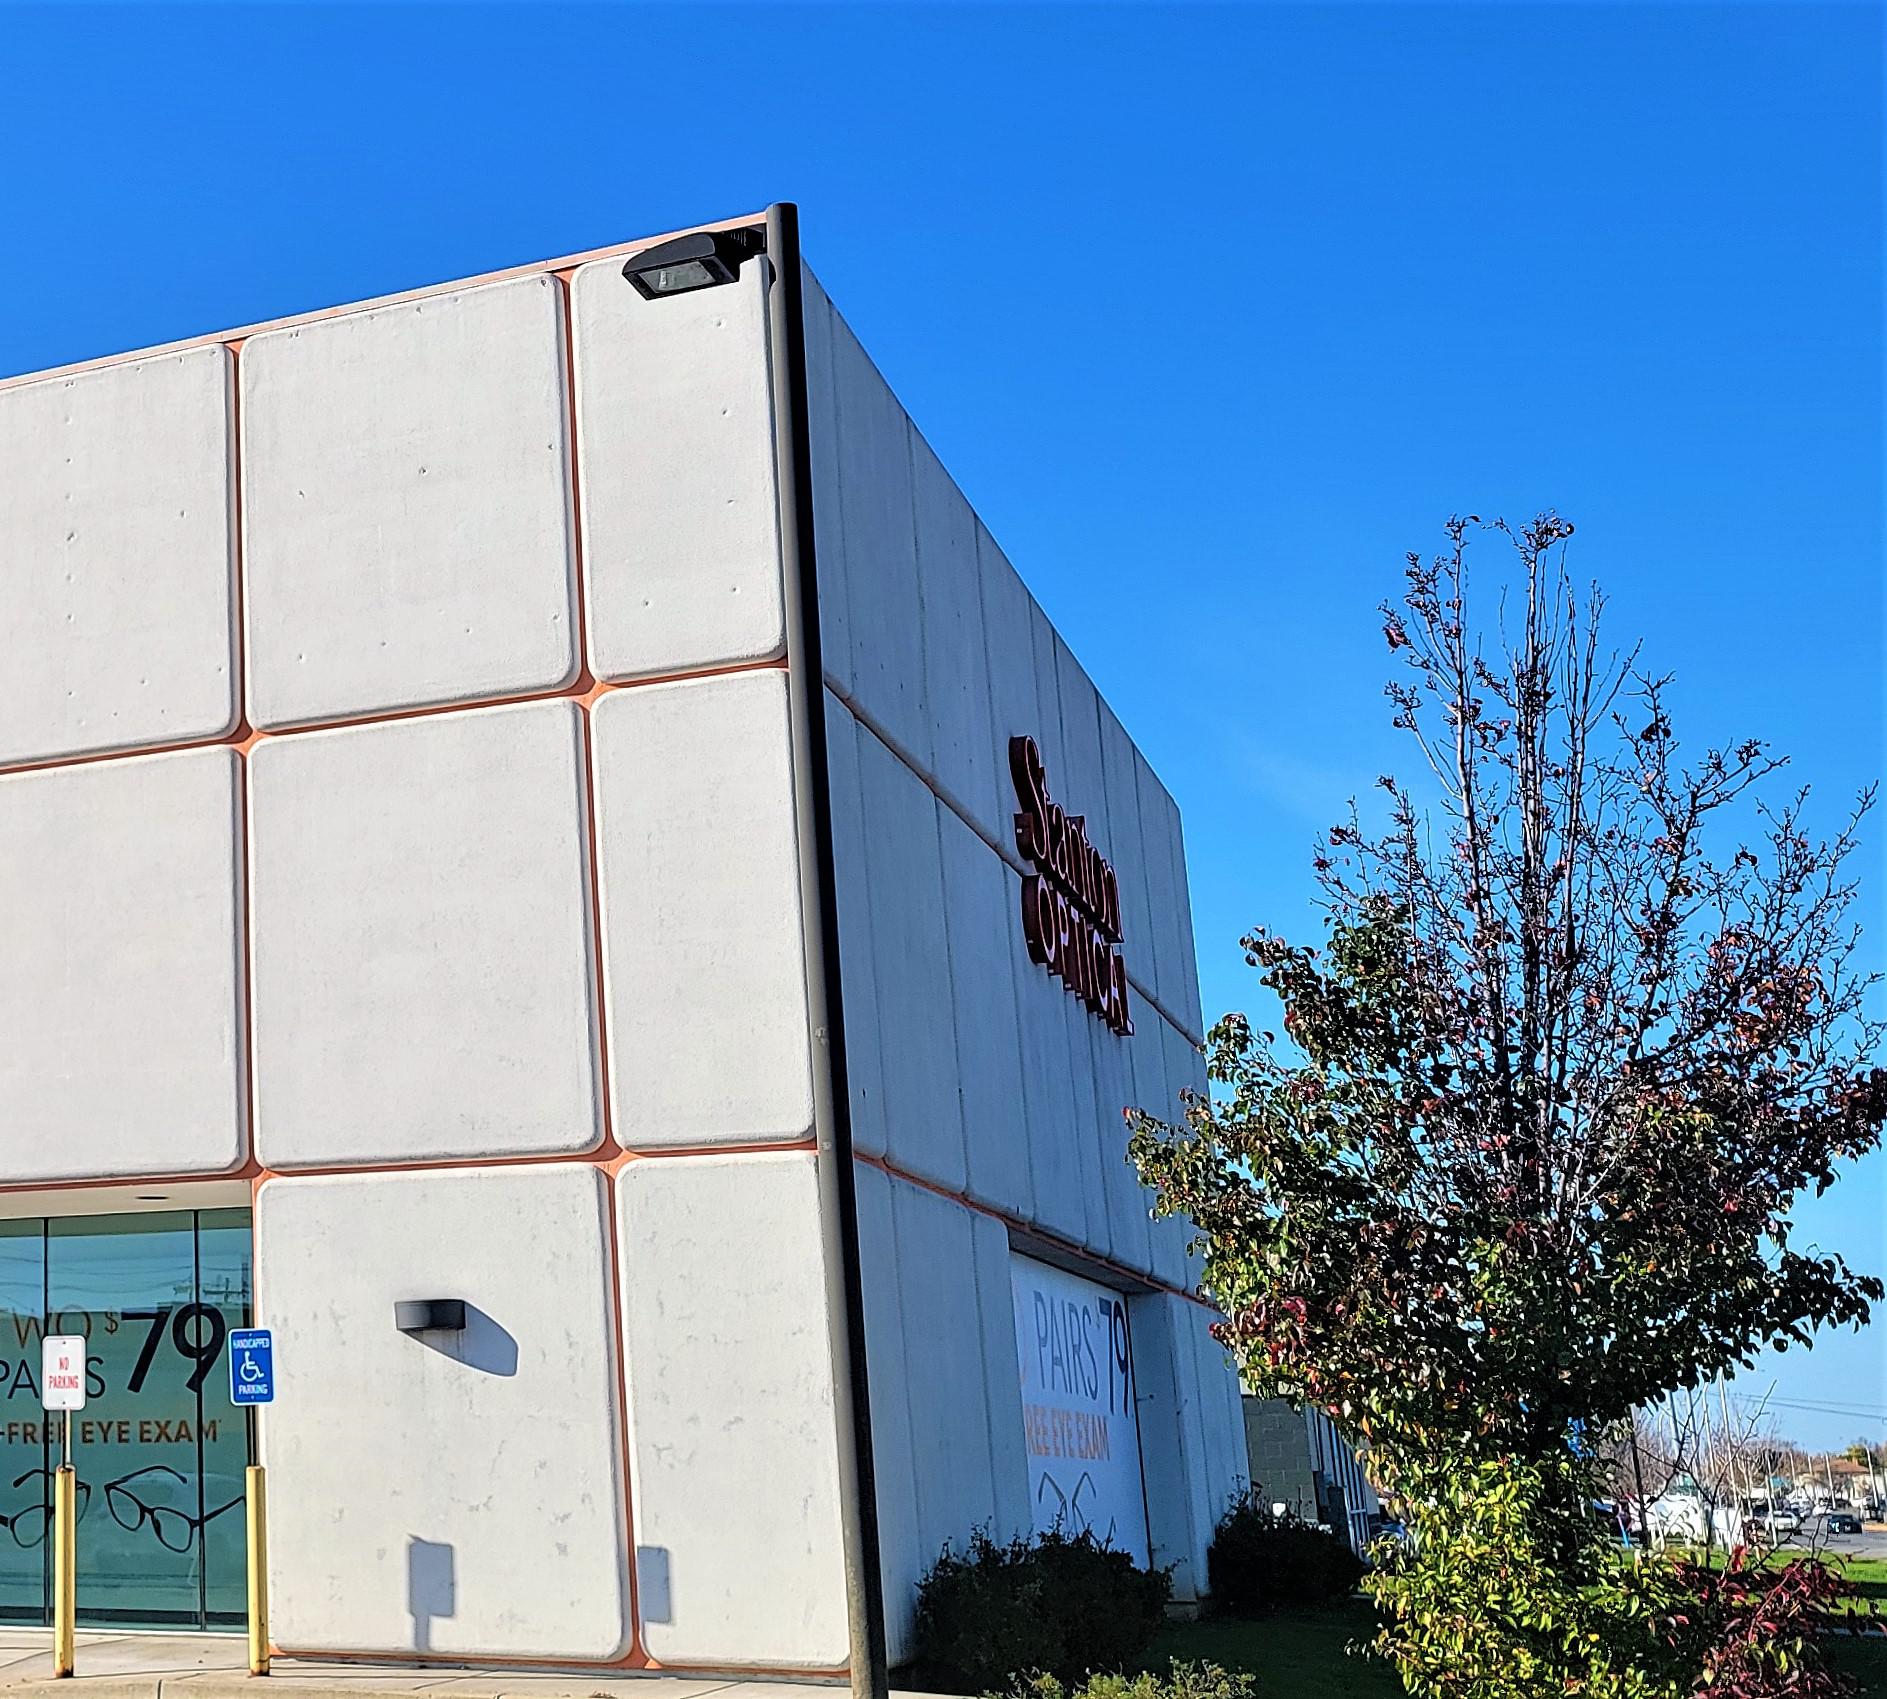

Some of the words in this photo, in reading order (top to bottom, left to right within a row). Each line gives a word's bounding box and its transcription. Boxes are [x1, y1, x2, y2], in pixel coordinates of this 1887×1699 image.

[1009, 736, 1124, 943] Stanton
[1033, 1290, 1098, 1401] PAIRS
[58, 1357, 69, 1371] NO
[48, 1376, 79, 1389] PARKING
[238, 1383, 268, 1394] PARKING
[81, 1420, 130, 1443] EYE
[1076, 1412, 1110, 1462] EXAM
